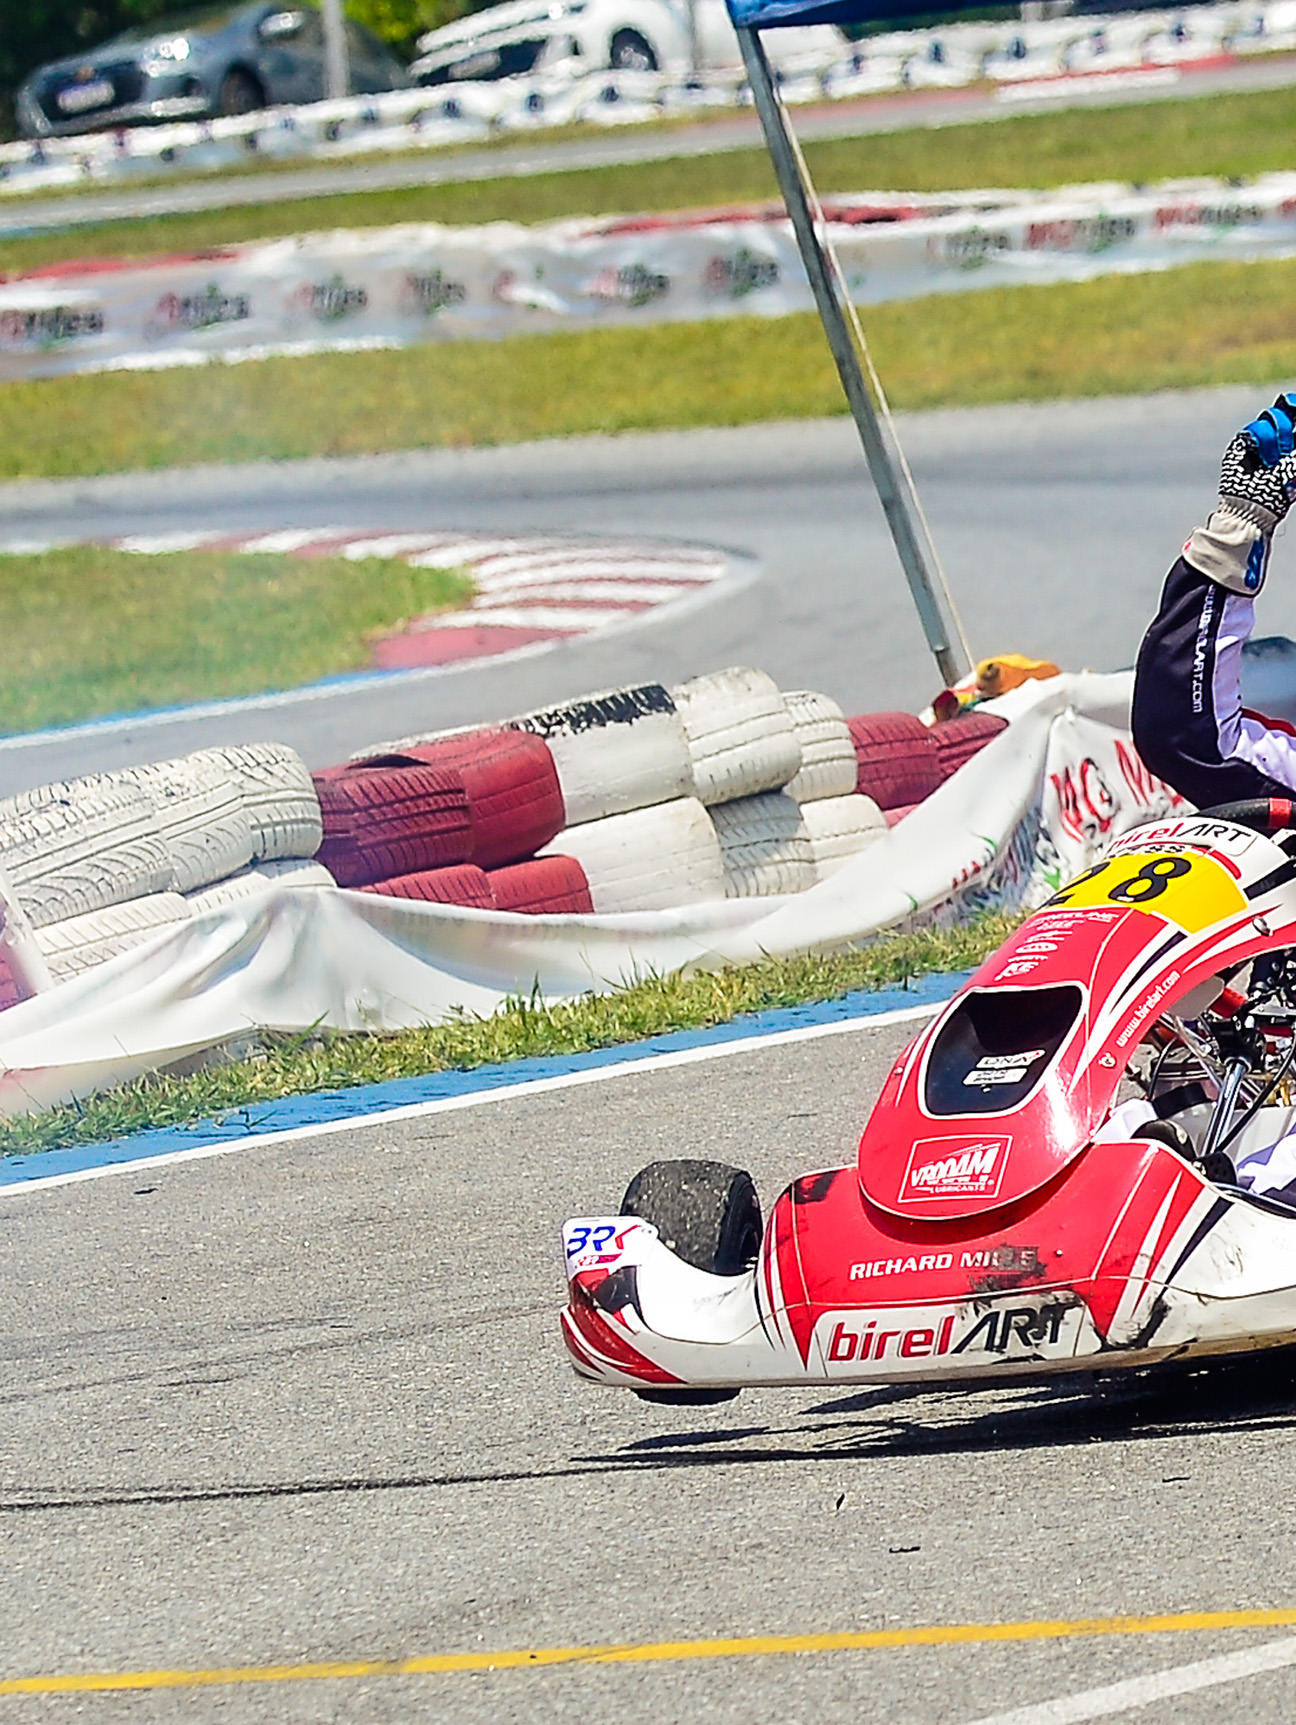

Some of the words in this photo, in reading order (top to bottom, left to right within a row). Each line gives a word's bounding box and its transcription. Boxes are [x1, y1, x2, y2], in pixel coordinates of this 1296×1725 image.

[849, 1252, 953, 1281] RICHARD
[960, 1250, 1036, 1268] MILE
[828, 1301, 1084, 1362] birelART
